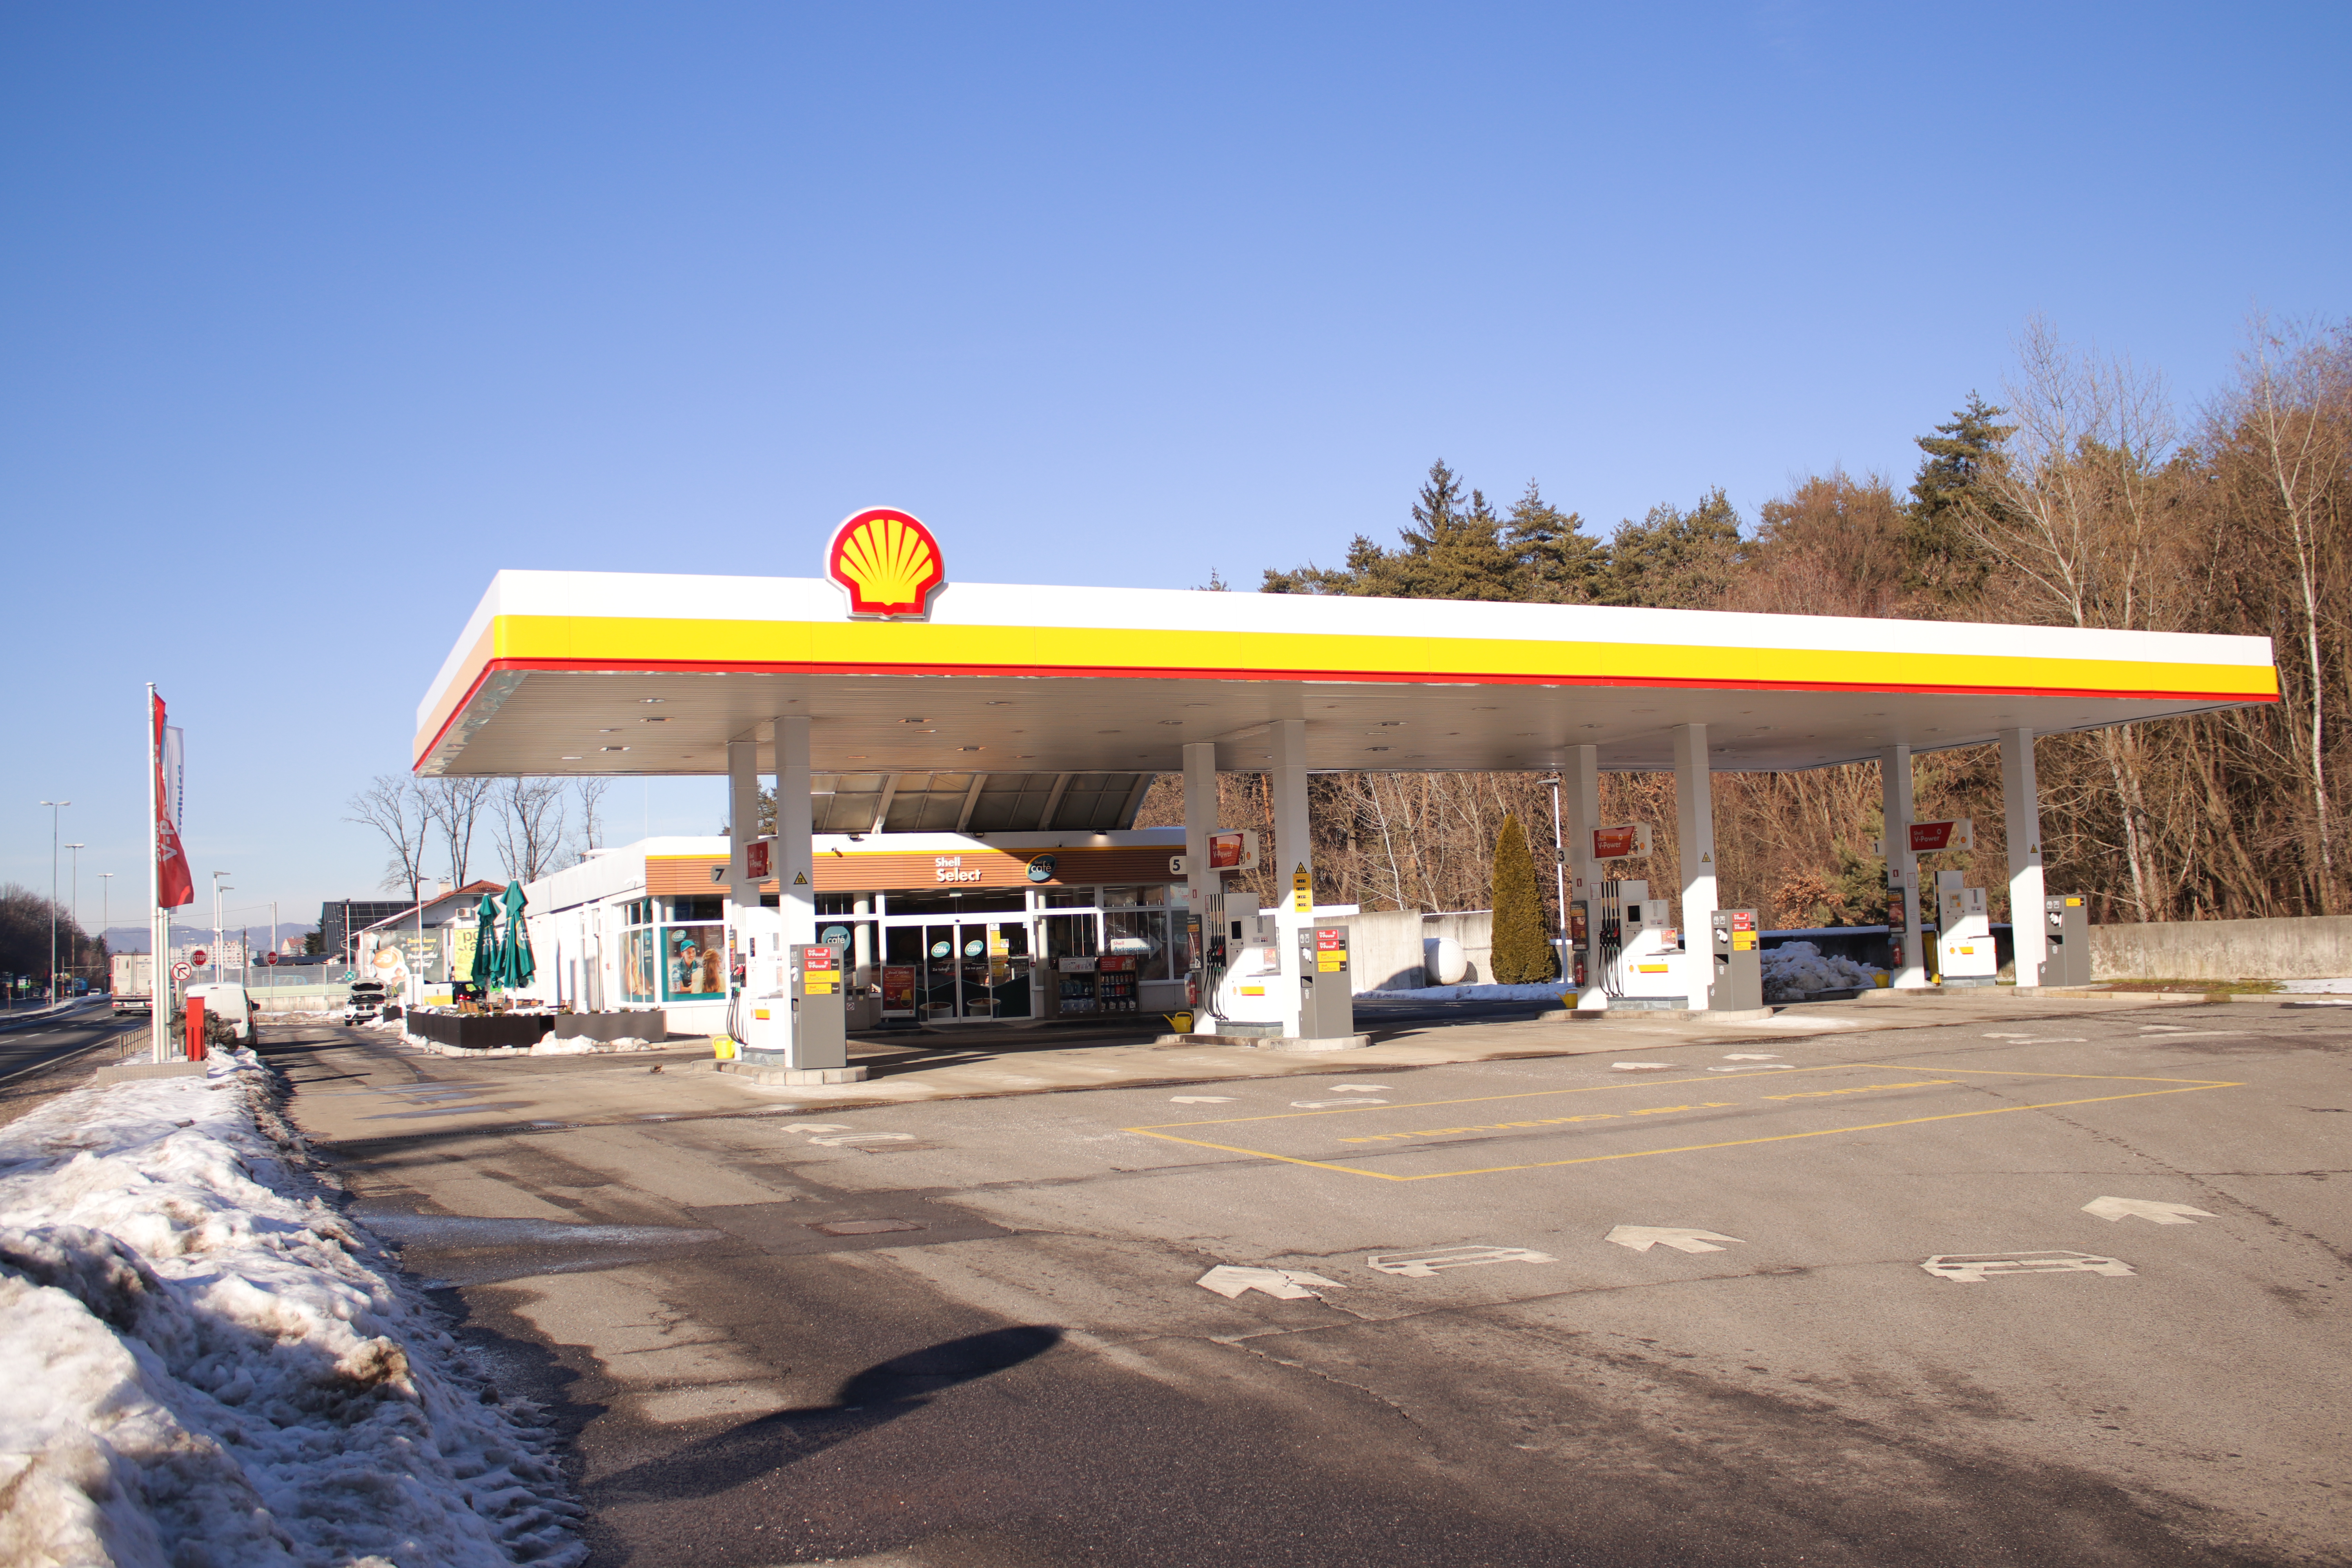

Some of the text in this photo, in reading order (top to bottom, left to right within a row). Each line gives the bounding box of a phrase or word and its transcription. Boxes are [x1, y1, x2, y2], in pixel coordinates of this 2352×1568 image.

[1874, 843, 1878, 853] 1
[935, 857, 960, 867] Shell
[1558, 851, 1564, 862] 3
[1031, 860, 1051, 873] café
[1172, 859, 1180, 871] 5
[715, 868, 725, 881] 7
[936, 867, 981, 882] Select
[828, 934, 845, 944] café
